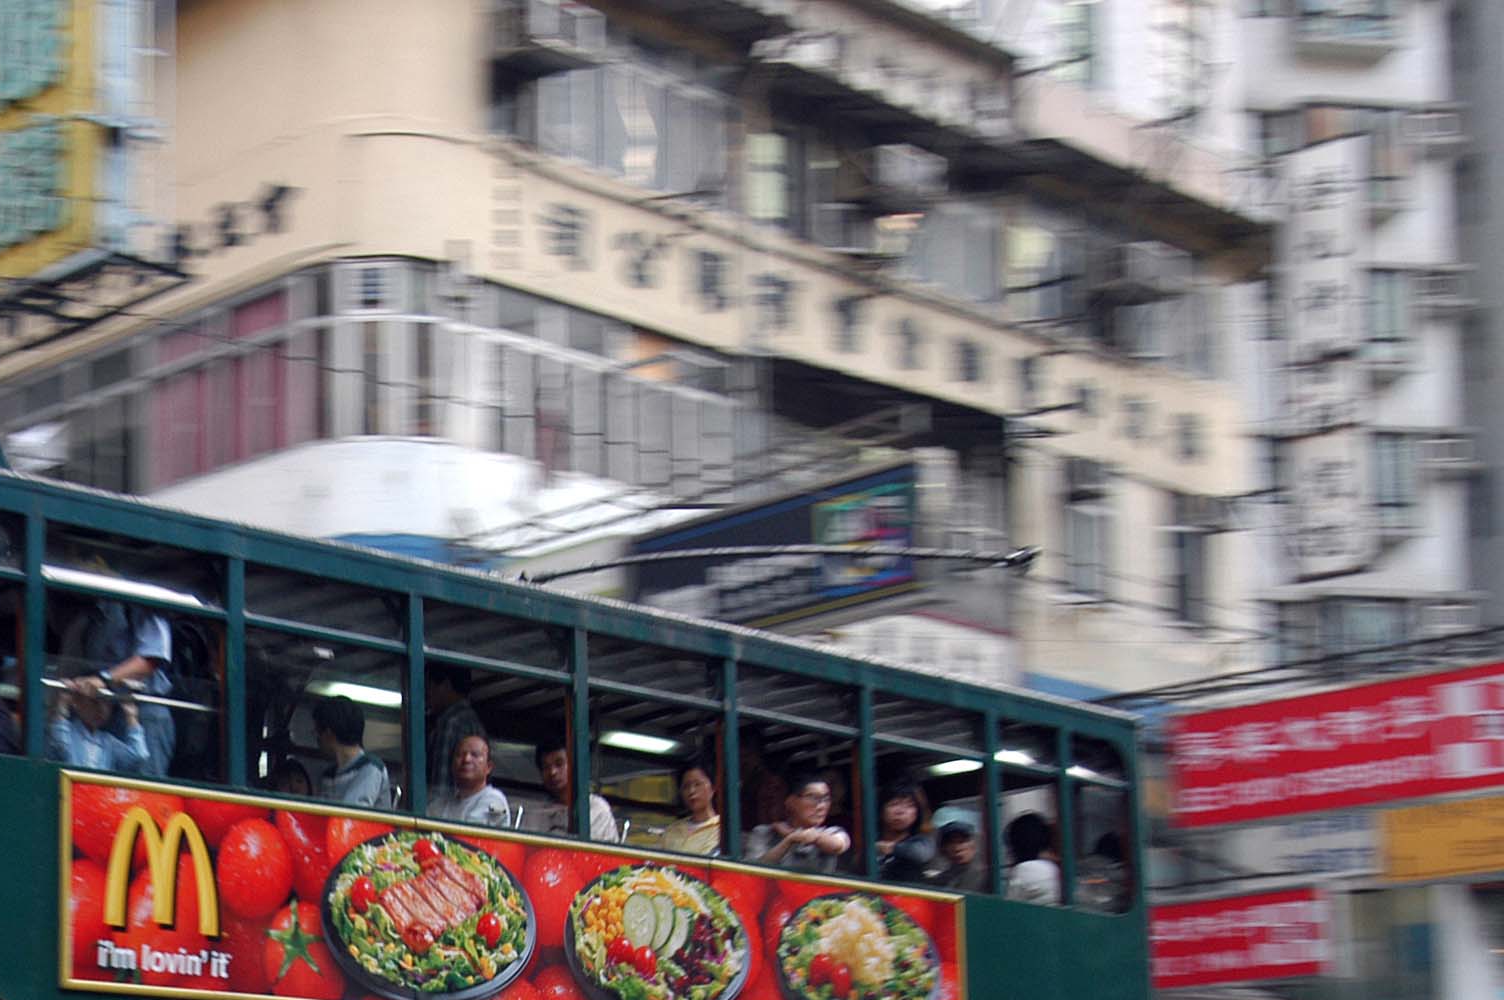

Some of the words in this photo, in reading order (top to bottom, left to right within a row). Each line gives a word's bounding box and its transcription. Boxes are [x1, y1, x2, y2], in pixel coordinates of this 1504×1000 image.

[97, 939, 137, 970] i'm
[140, 943, 208, 976] lovin'
[210, 950, 231, 979] it
